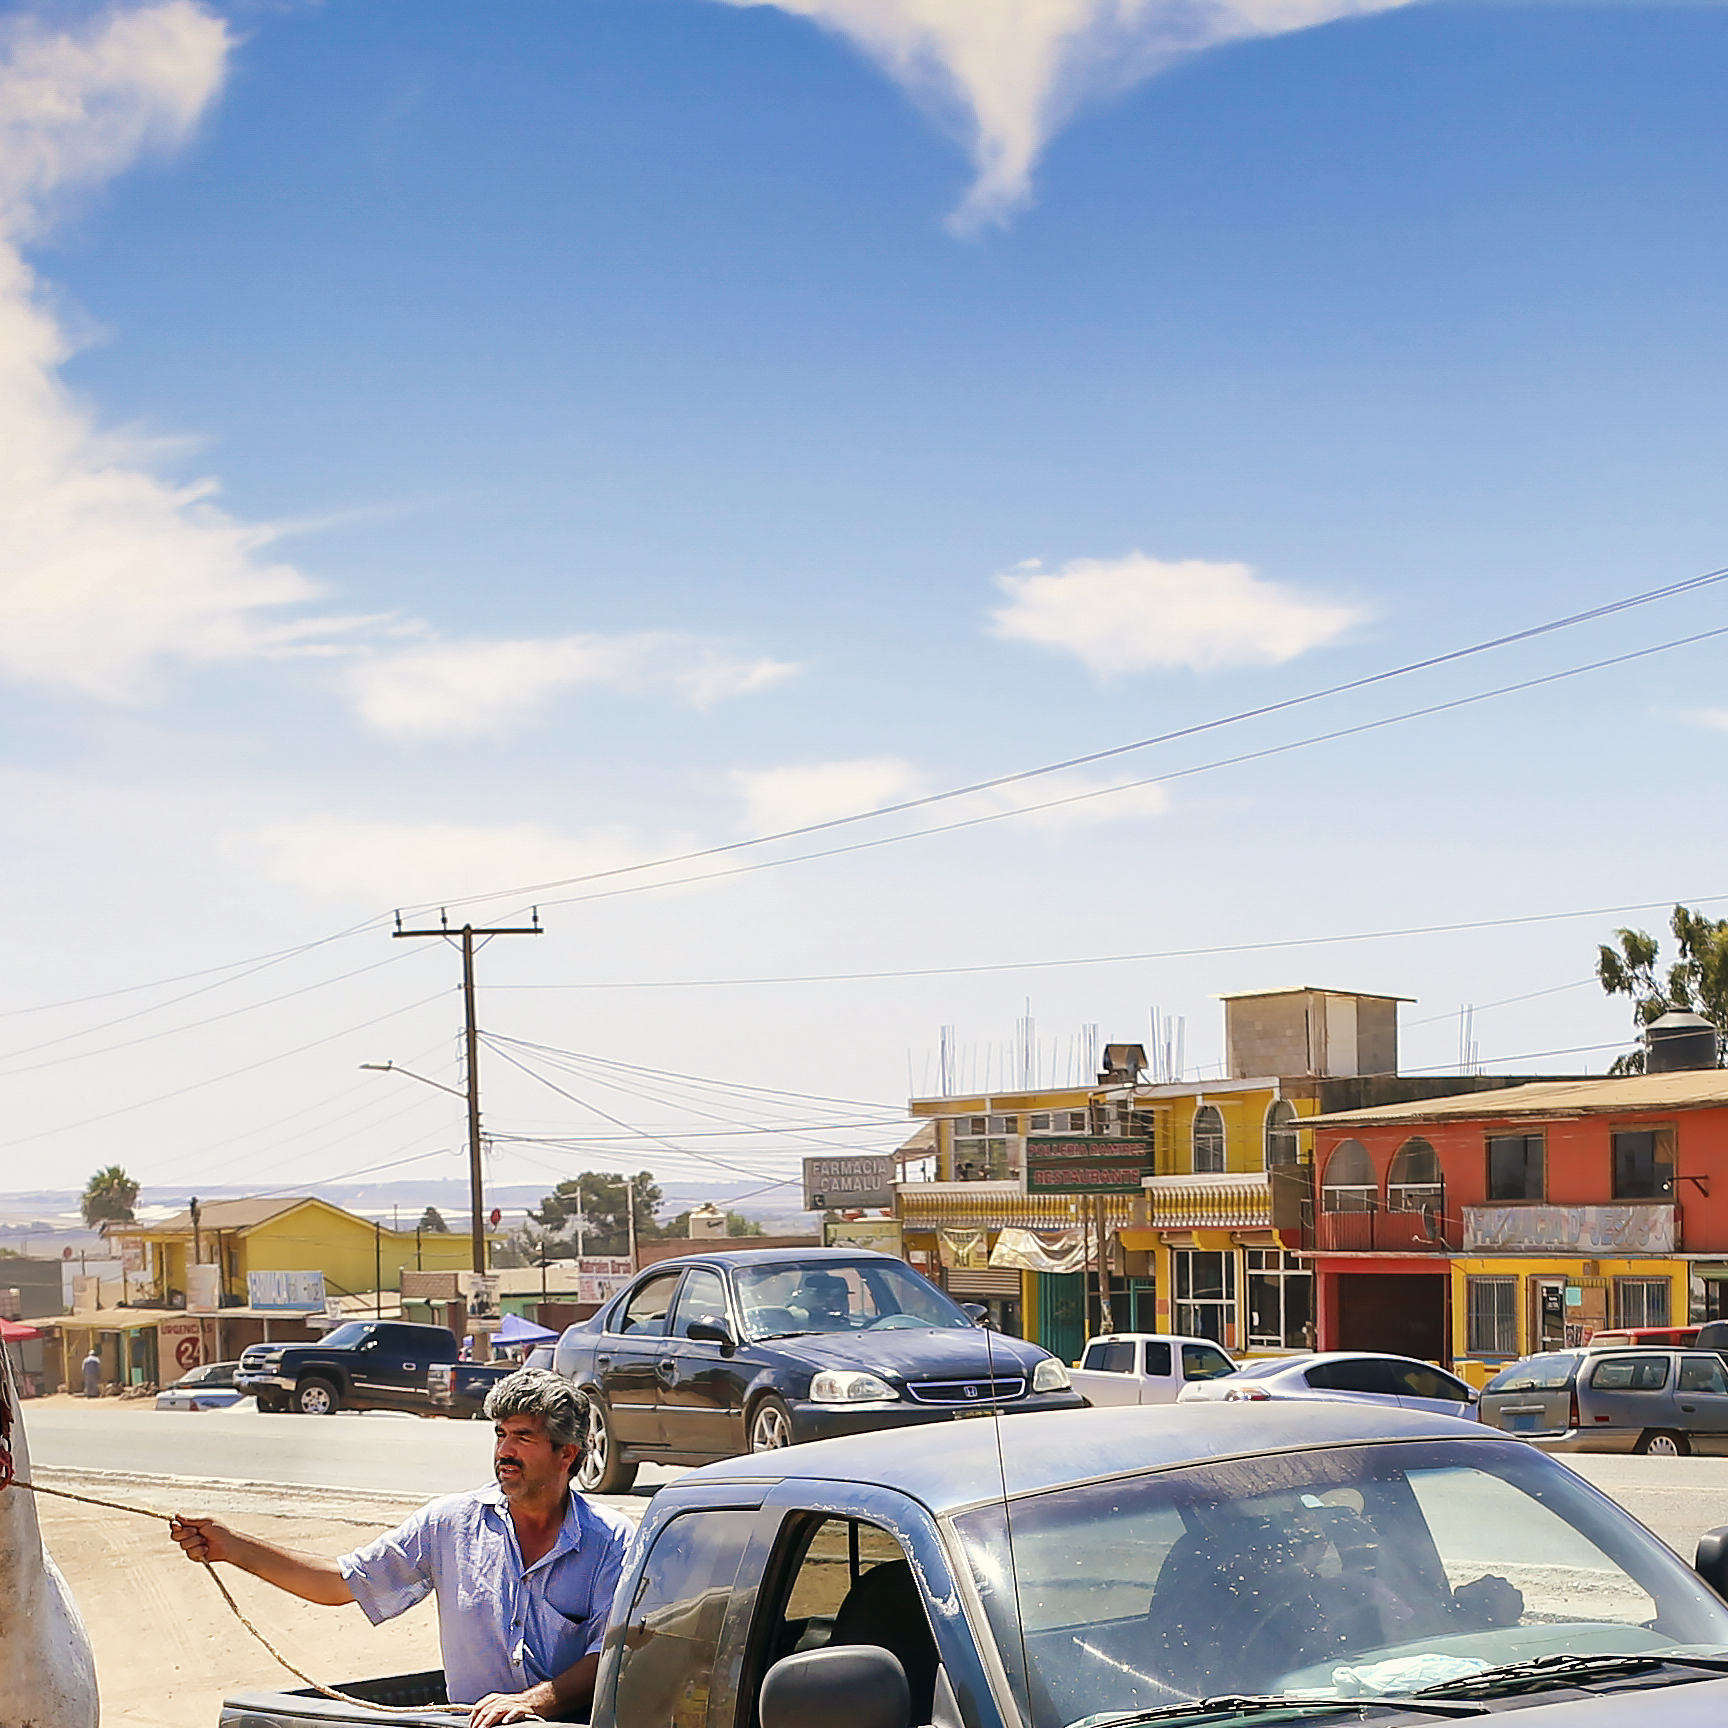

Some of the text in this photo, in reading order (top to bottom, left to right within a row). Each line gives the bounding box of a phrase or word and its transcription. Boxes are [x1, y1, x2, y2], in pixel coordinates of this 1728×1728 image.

[812, 1159, 888, 1176] FARMACIA
[820, 1175, 882, 1193] CAMALU
[1033, 1168, 1141, 1185] RESTAURANTE
[161, 1323, 213, 1335] URGENCS
